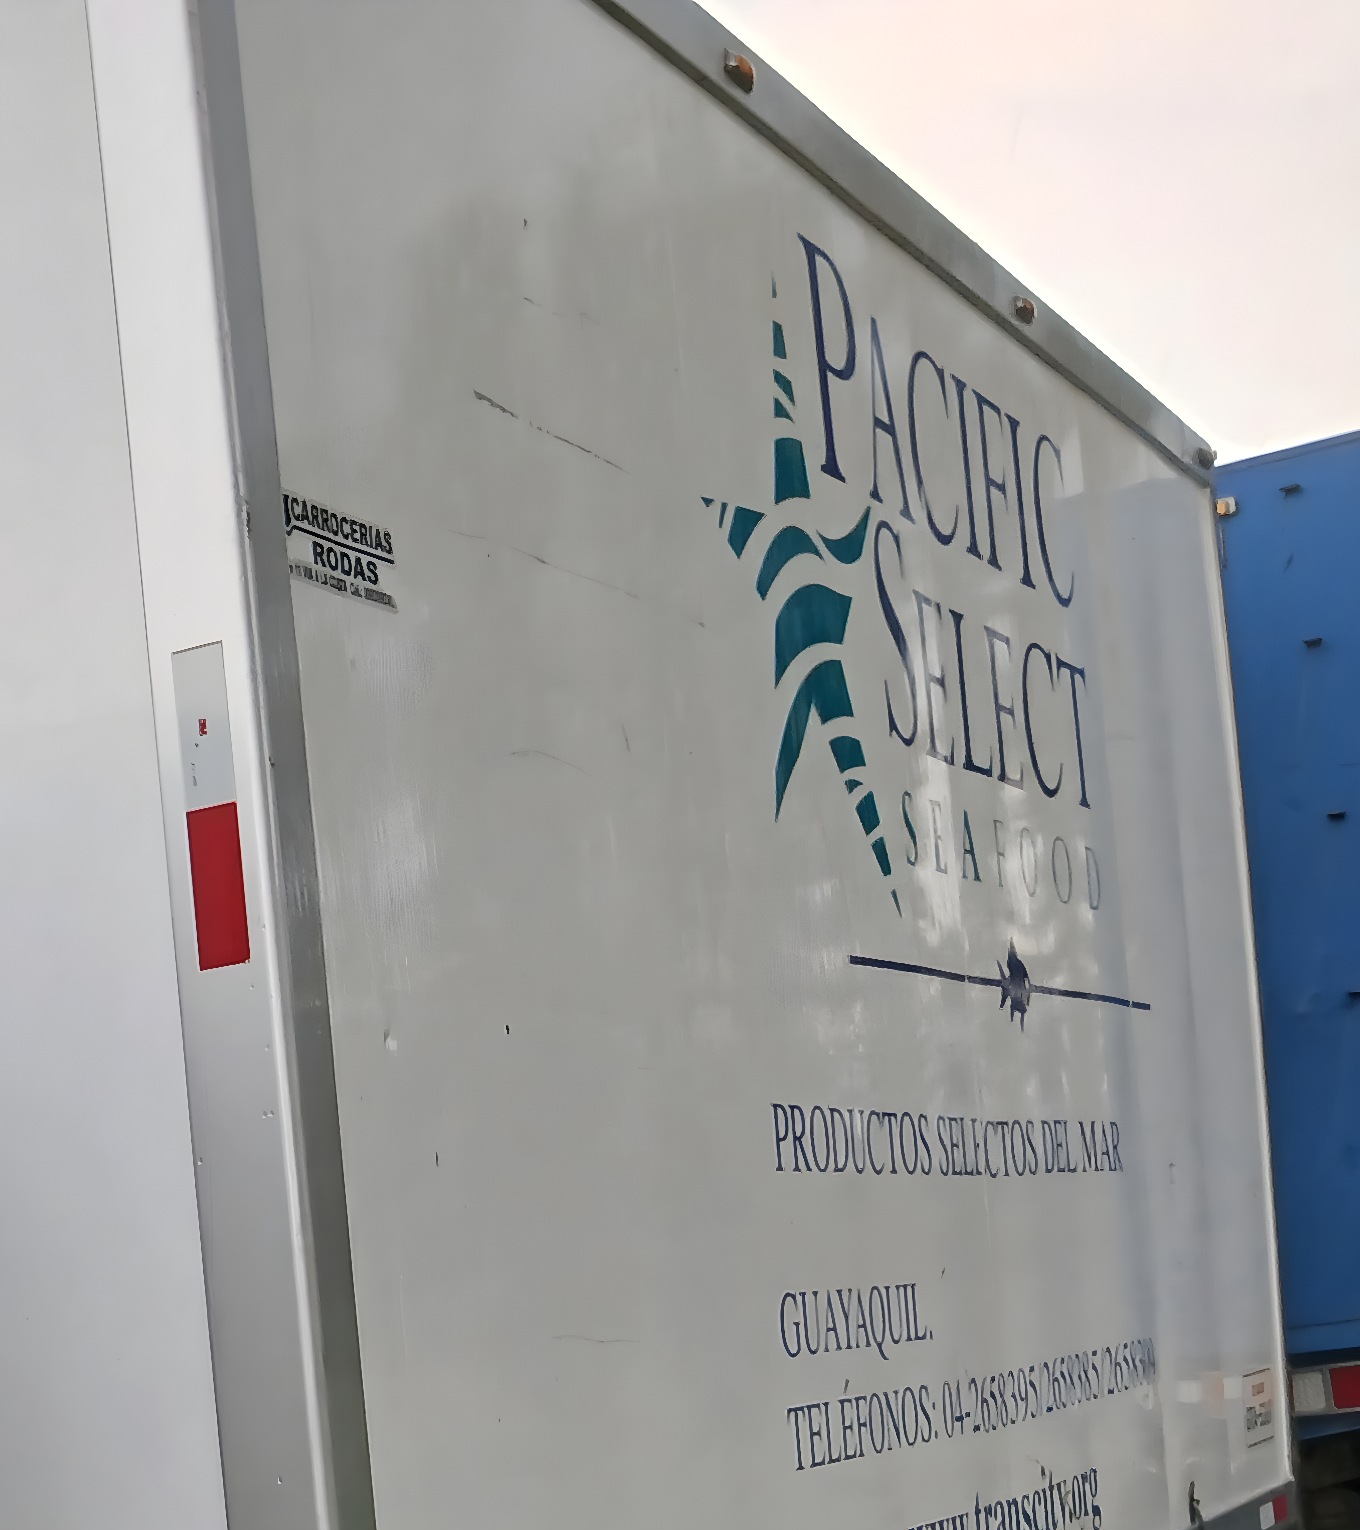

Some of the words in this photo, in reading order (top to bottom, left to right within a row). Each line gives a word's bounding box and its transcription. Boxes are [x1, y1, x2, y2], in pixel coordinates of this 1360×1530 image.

[797, 232, 1075, 608] PACIFIC
[290, 497, 394, 555] CARROCERIAS
[312, 540, 379, 586] RODAS
[874, 519, 1091, 810] SELECT
[901, 790, 1101, 911] SEAFOOD
[771, 1102, 933, 1176] PRODUCTOS
[937, 1115, 1039, 1179] SELECTOS
[1041, 1119, 1077, 1174] DEL
[1078, 1120, 1124, 1173] MAR
[780, 1283, 933, 1361] GUAYAQUIL.
[786, 1379, 939, 1471] TELÉFONOS:
